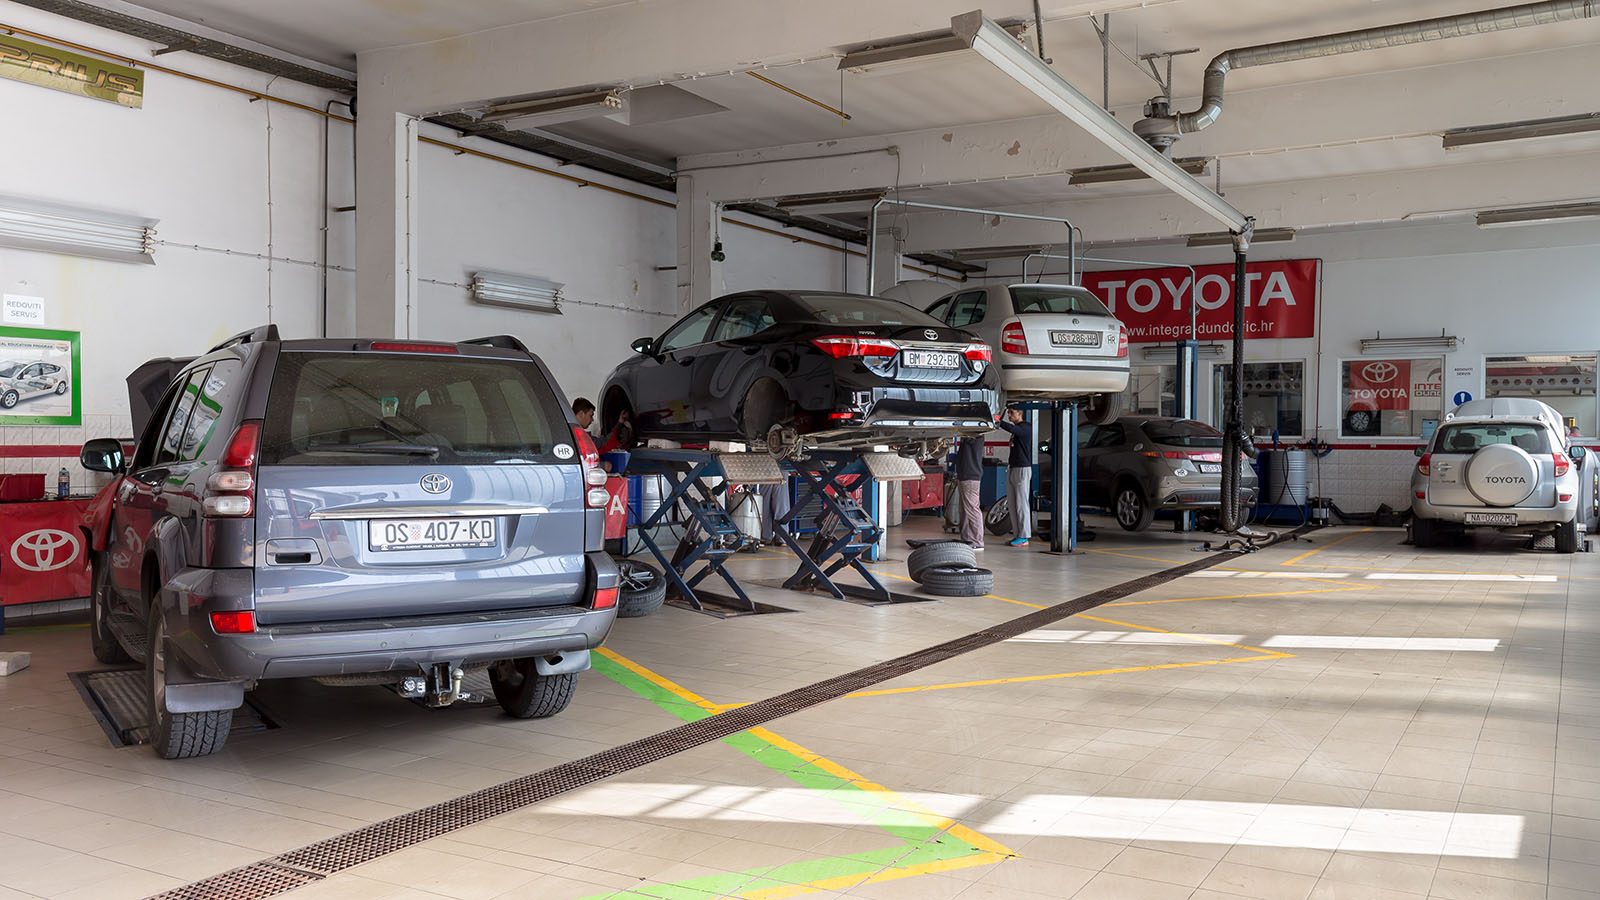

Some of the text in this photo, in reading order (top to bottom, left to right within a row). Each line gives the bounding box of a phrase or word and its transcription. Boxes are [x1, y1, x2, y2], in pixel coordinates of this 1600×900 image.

[0, 42, 141, 95] PRIUS
[1098, 271, 1297, 313] TOYOTA
[6, 301, 41, 309] REDOVITI
[11, 310, 37, 318] SERVIS
[909, 353, 920, 365] BM
[1352, 388, 1408, 399] TOYOTA
[557, 447, 571, 455] HR
[1485, 476, 1526, 484] TOYOTA
[385, 520, 492, 543] OS 407-KD
